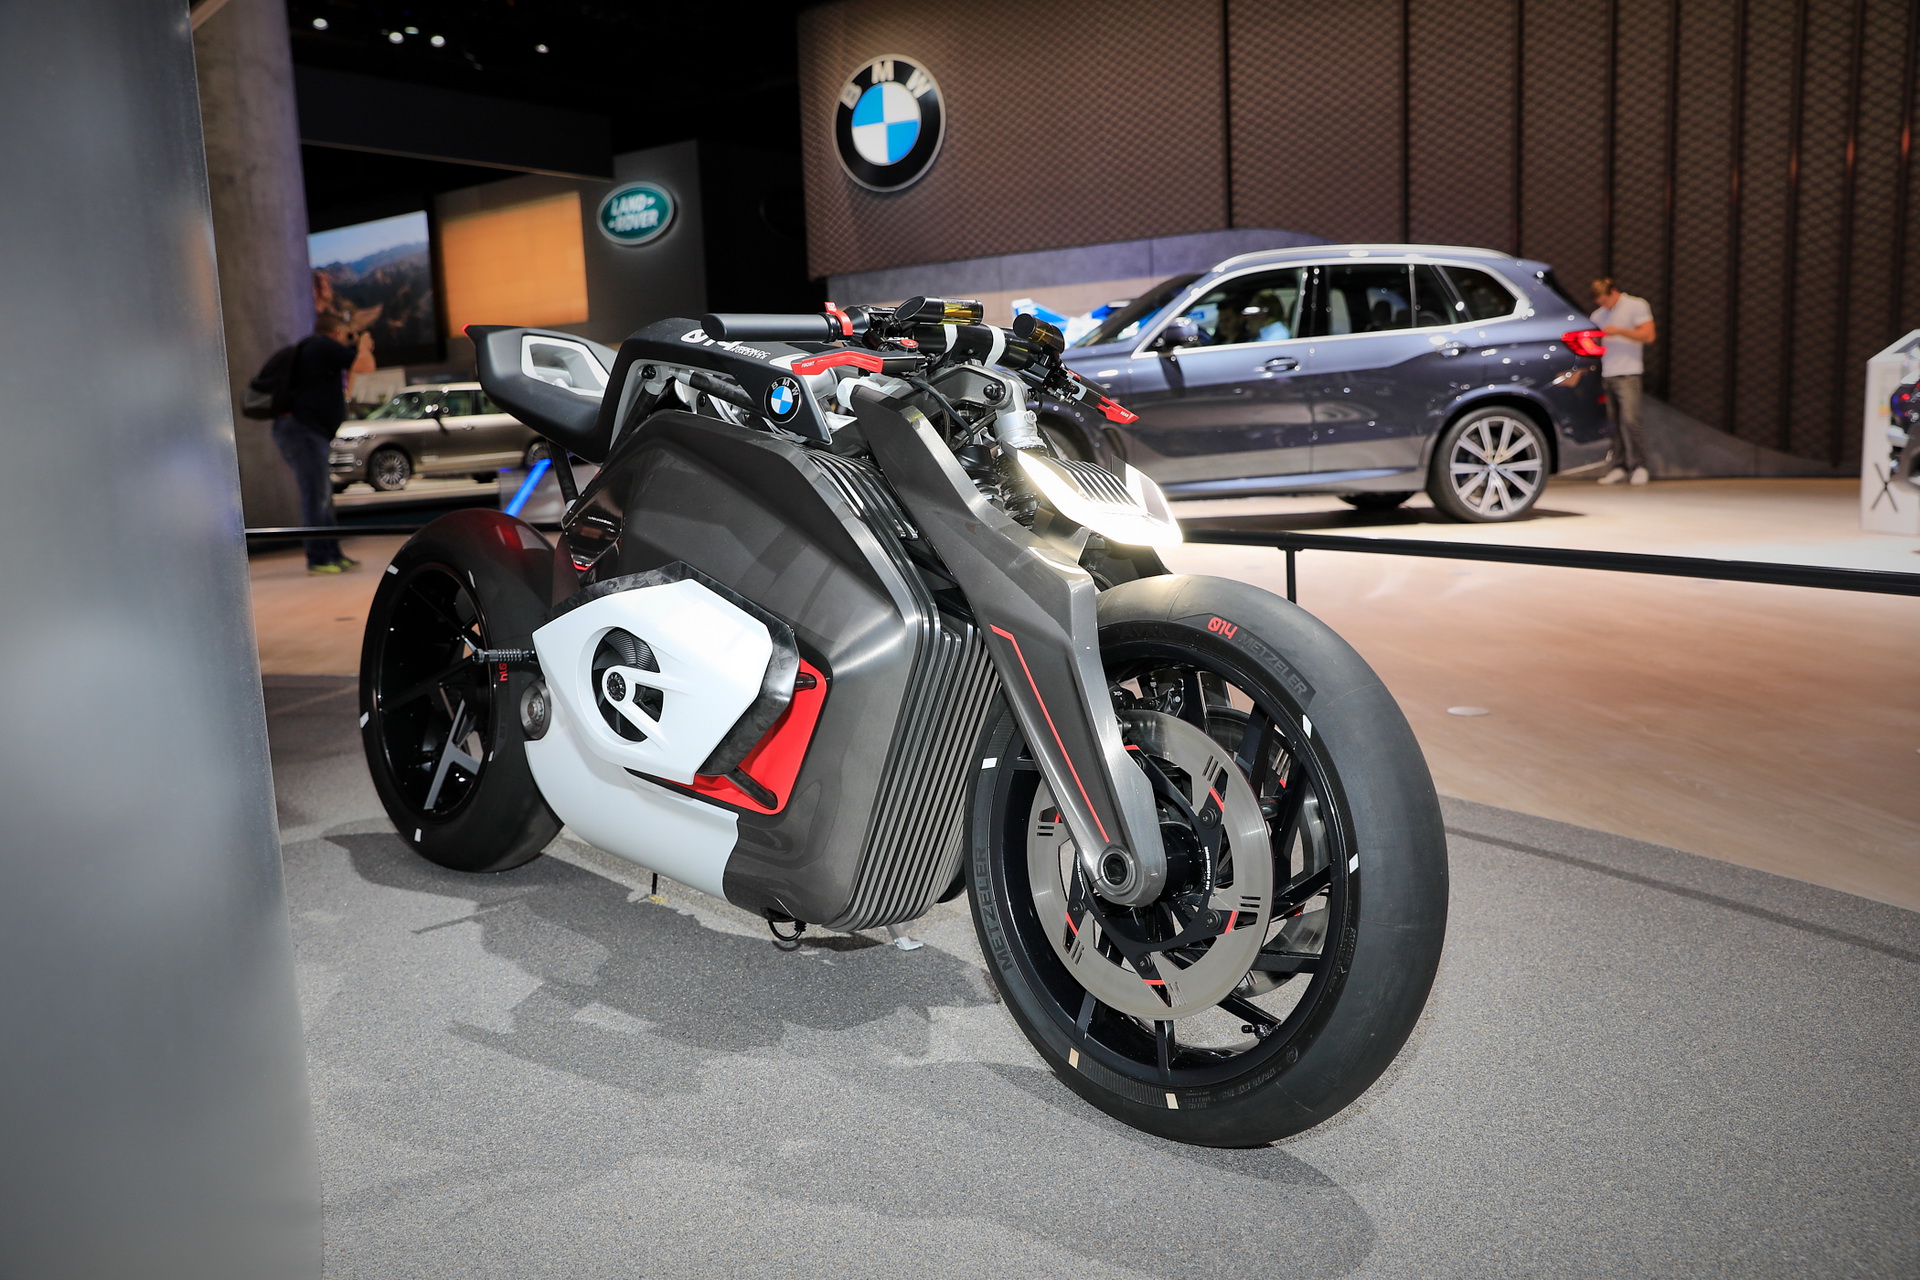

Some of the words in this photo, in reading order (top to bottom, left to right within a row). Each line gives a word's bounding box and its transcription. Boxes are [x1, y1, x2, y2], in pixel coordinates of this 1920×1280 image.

[840, 60, 933, 110] BMW
[611, 194, 647, 216] LAND
[614, 209, 659, 232] ROVER
[771, 378, 799, 396] BMW
[1240, 633, 1308, 694] METZELER
[974, 849, 1013, 971] METZELER
